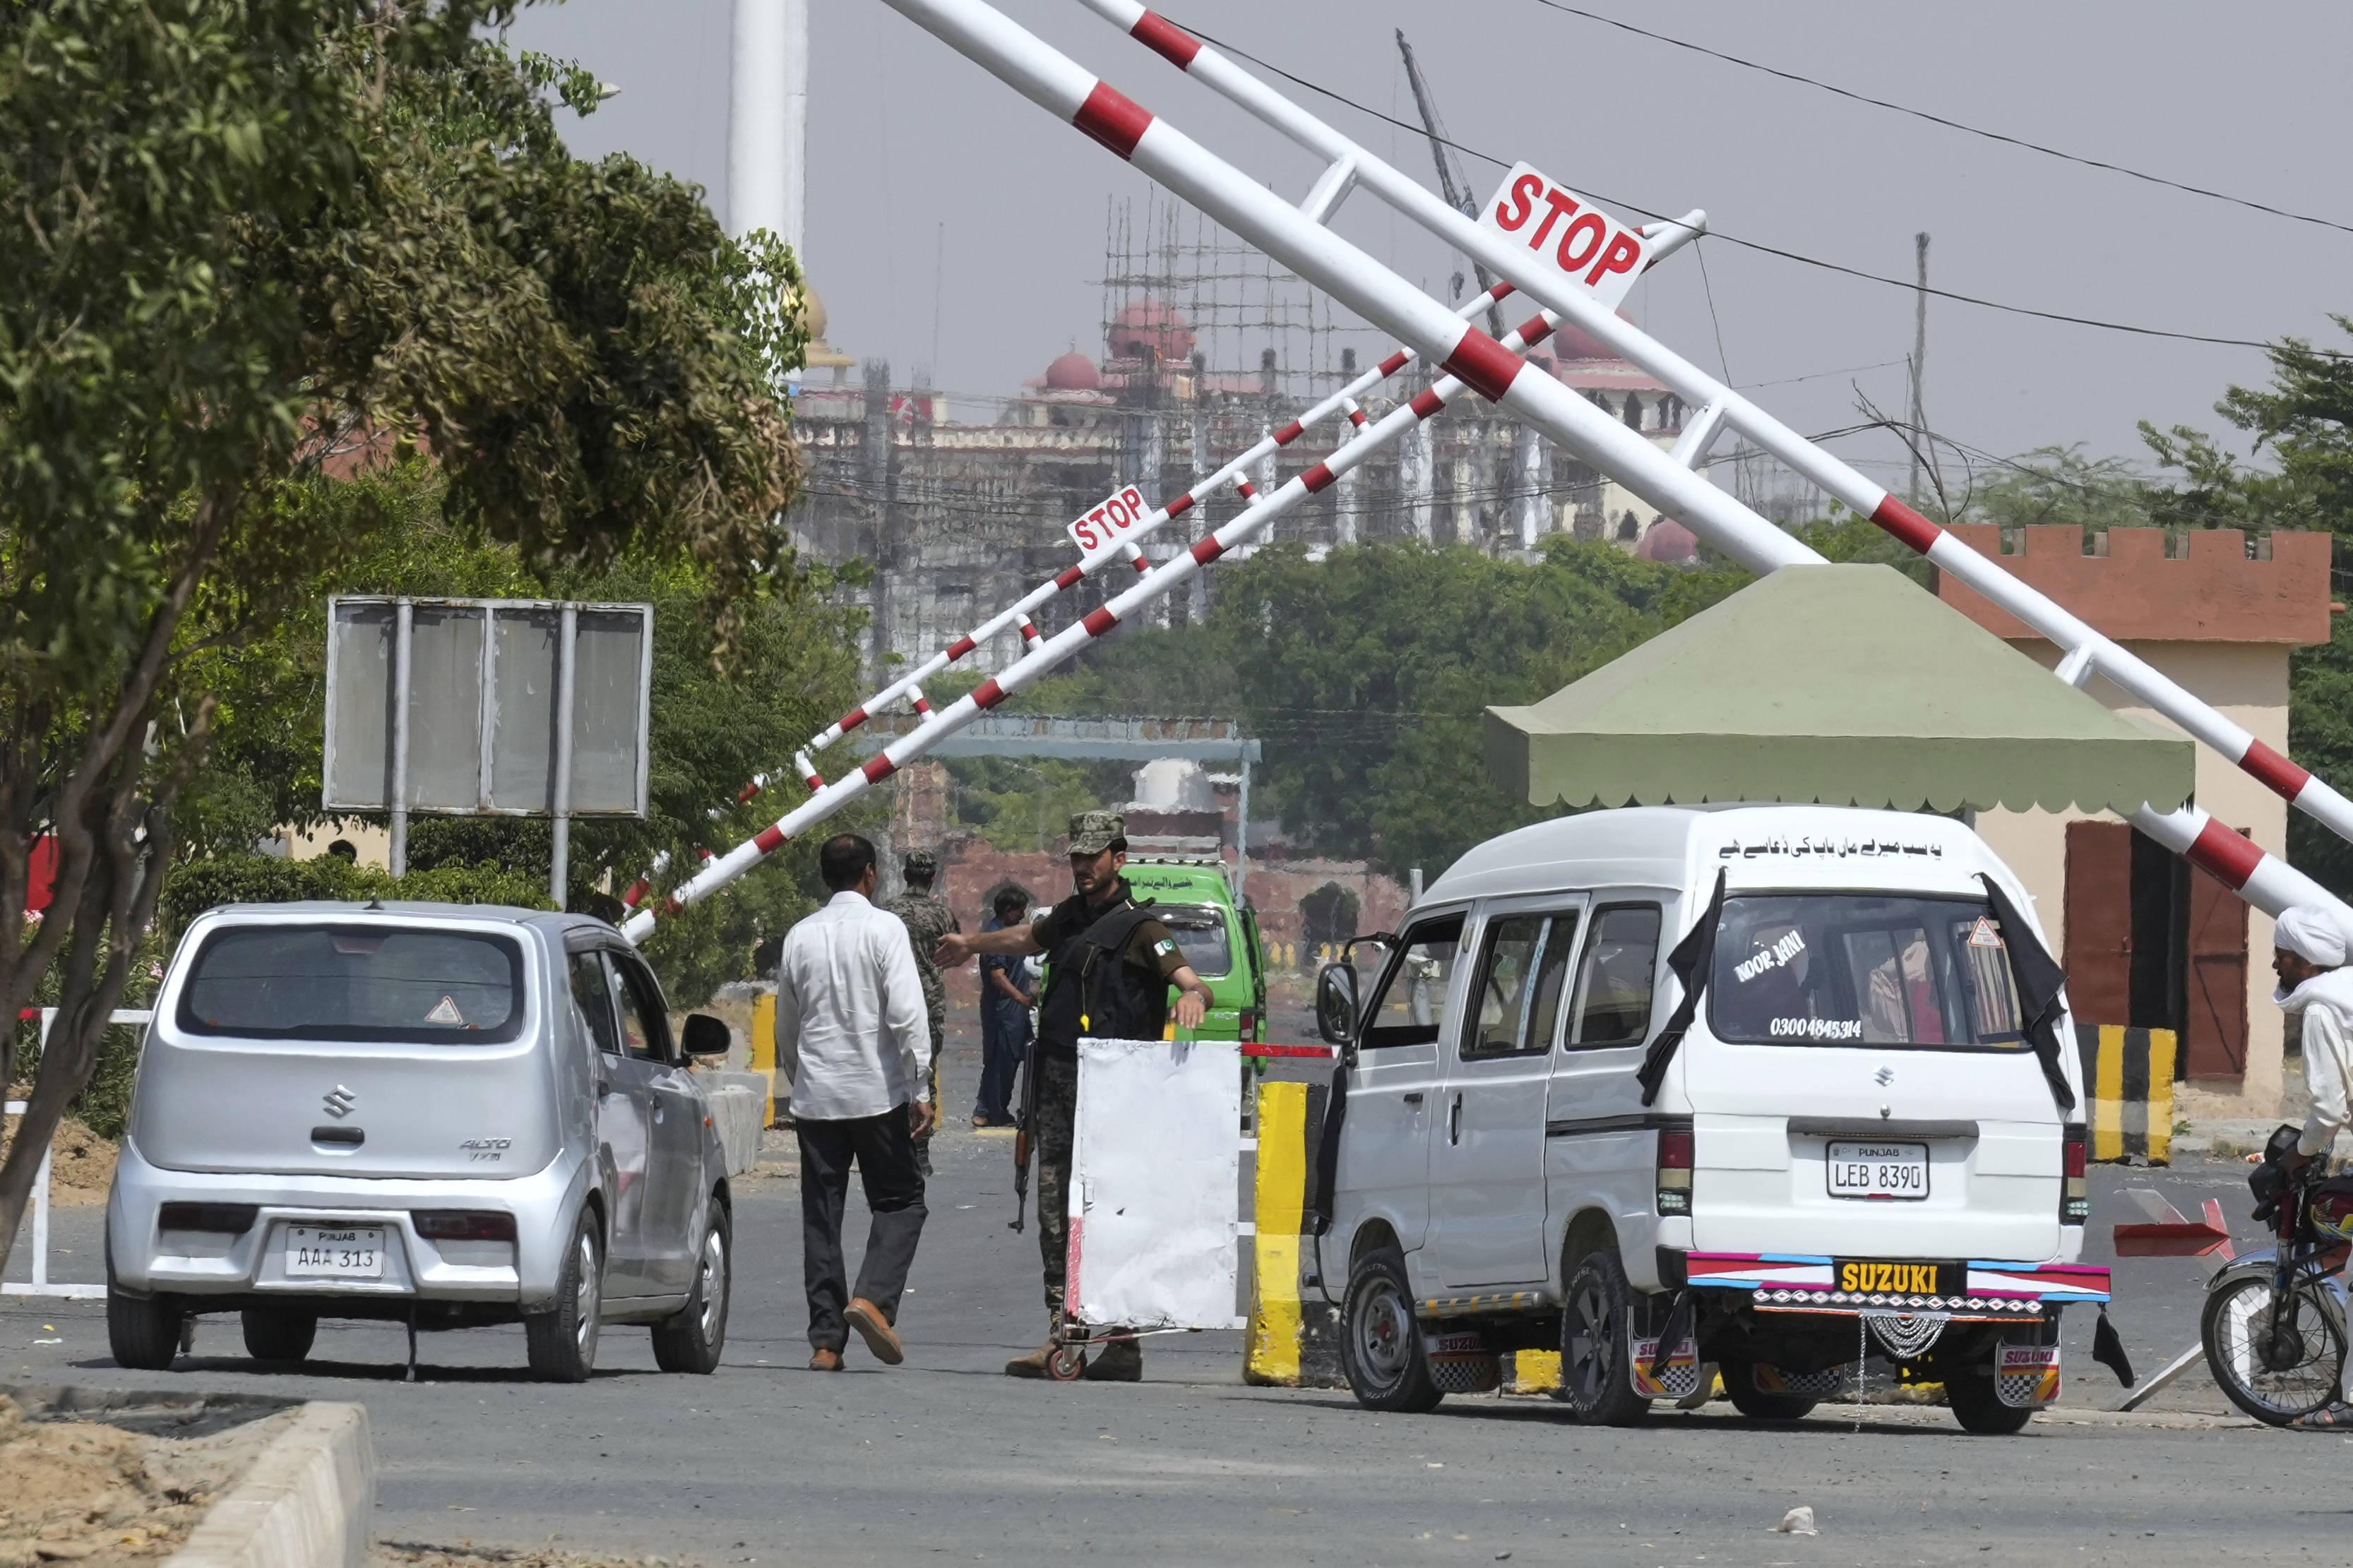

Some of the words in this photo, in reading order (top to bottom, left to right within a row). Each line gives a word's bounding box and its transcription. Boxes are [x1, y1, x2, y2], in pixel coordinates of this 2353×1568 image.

[1496, 174, 1640, 287] STOP
[1075, 489, 1141, 550] STOP
[1734, 950, 1775, 982] NOOR
[459, 1137, 511, 1149] ALTO
[1859, 1148, 1900, 1156] PUNJAB
[1836, 1164, 1869, 1187] LEB
[1879, 1166, 1920, 1188] 8390
[298, 1247, 333, 1266] AAA
[339, 1250, 374, 1267] 313
[1842, 1263, 1938, 1293] SUZUKI
[2004, 1349, 2055, 1363] SUZUKI
